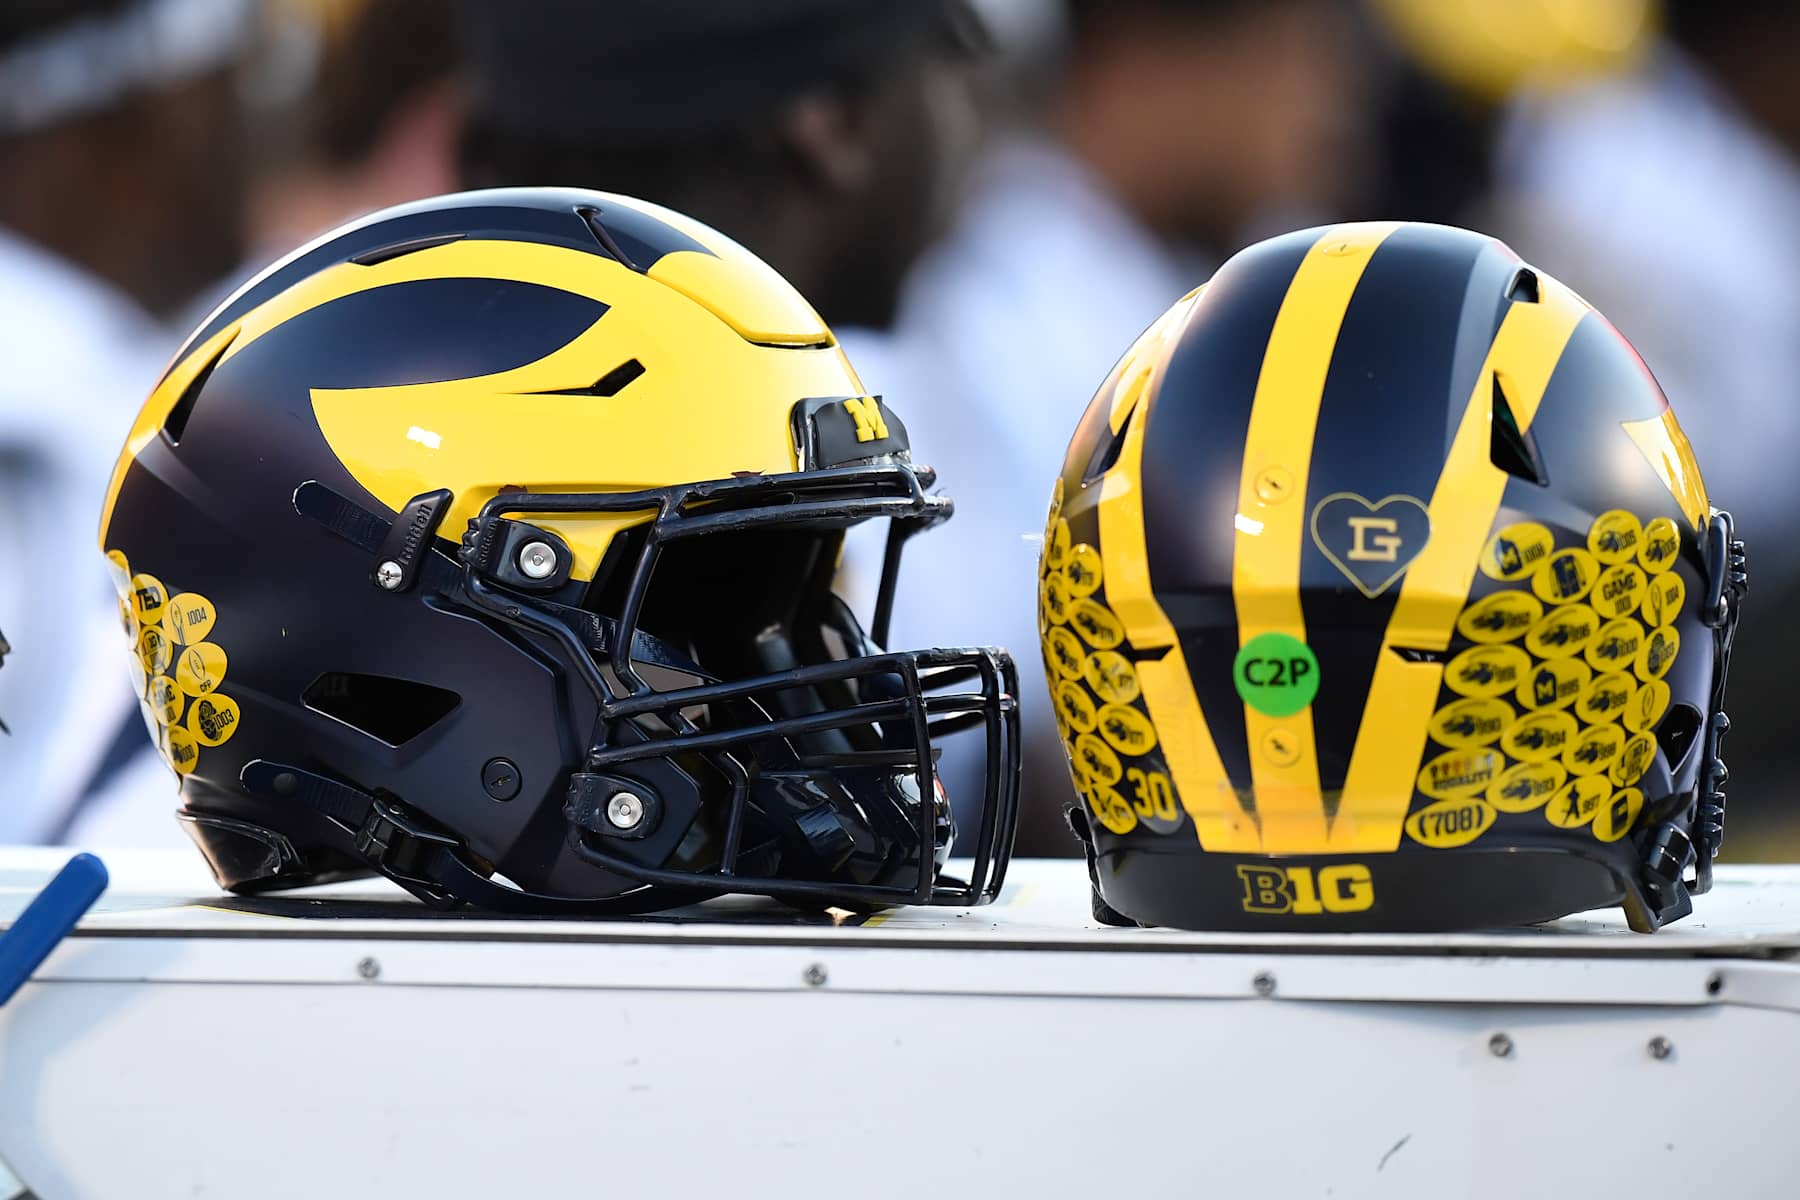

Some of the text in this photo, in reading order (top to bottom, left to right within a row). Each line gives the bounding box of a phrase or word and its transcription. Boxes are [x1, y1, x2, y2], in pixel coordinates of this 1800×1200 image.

[844, 396, 889, 443] M
[1346, 516, 1402, 562] G
[1603, 572, 1637, 601] GAME
[186, 607, 207, 626] 1004
[1244, 657, 1309, 687] C2P
[213, 708, 234, 730] 1003
[1126, 766, 1176, 822] 30
[1418, 804, 1484, 839] (708)
[1236, 863, 1376, 915] B1G
